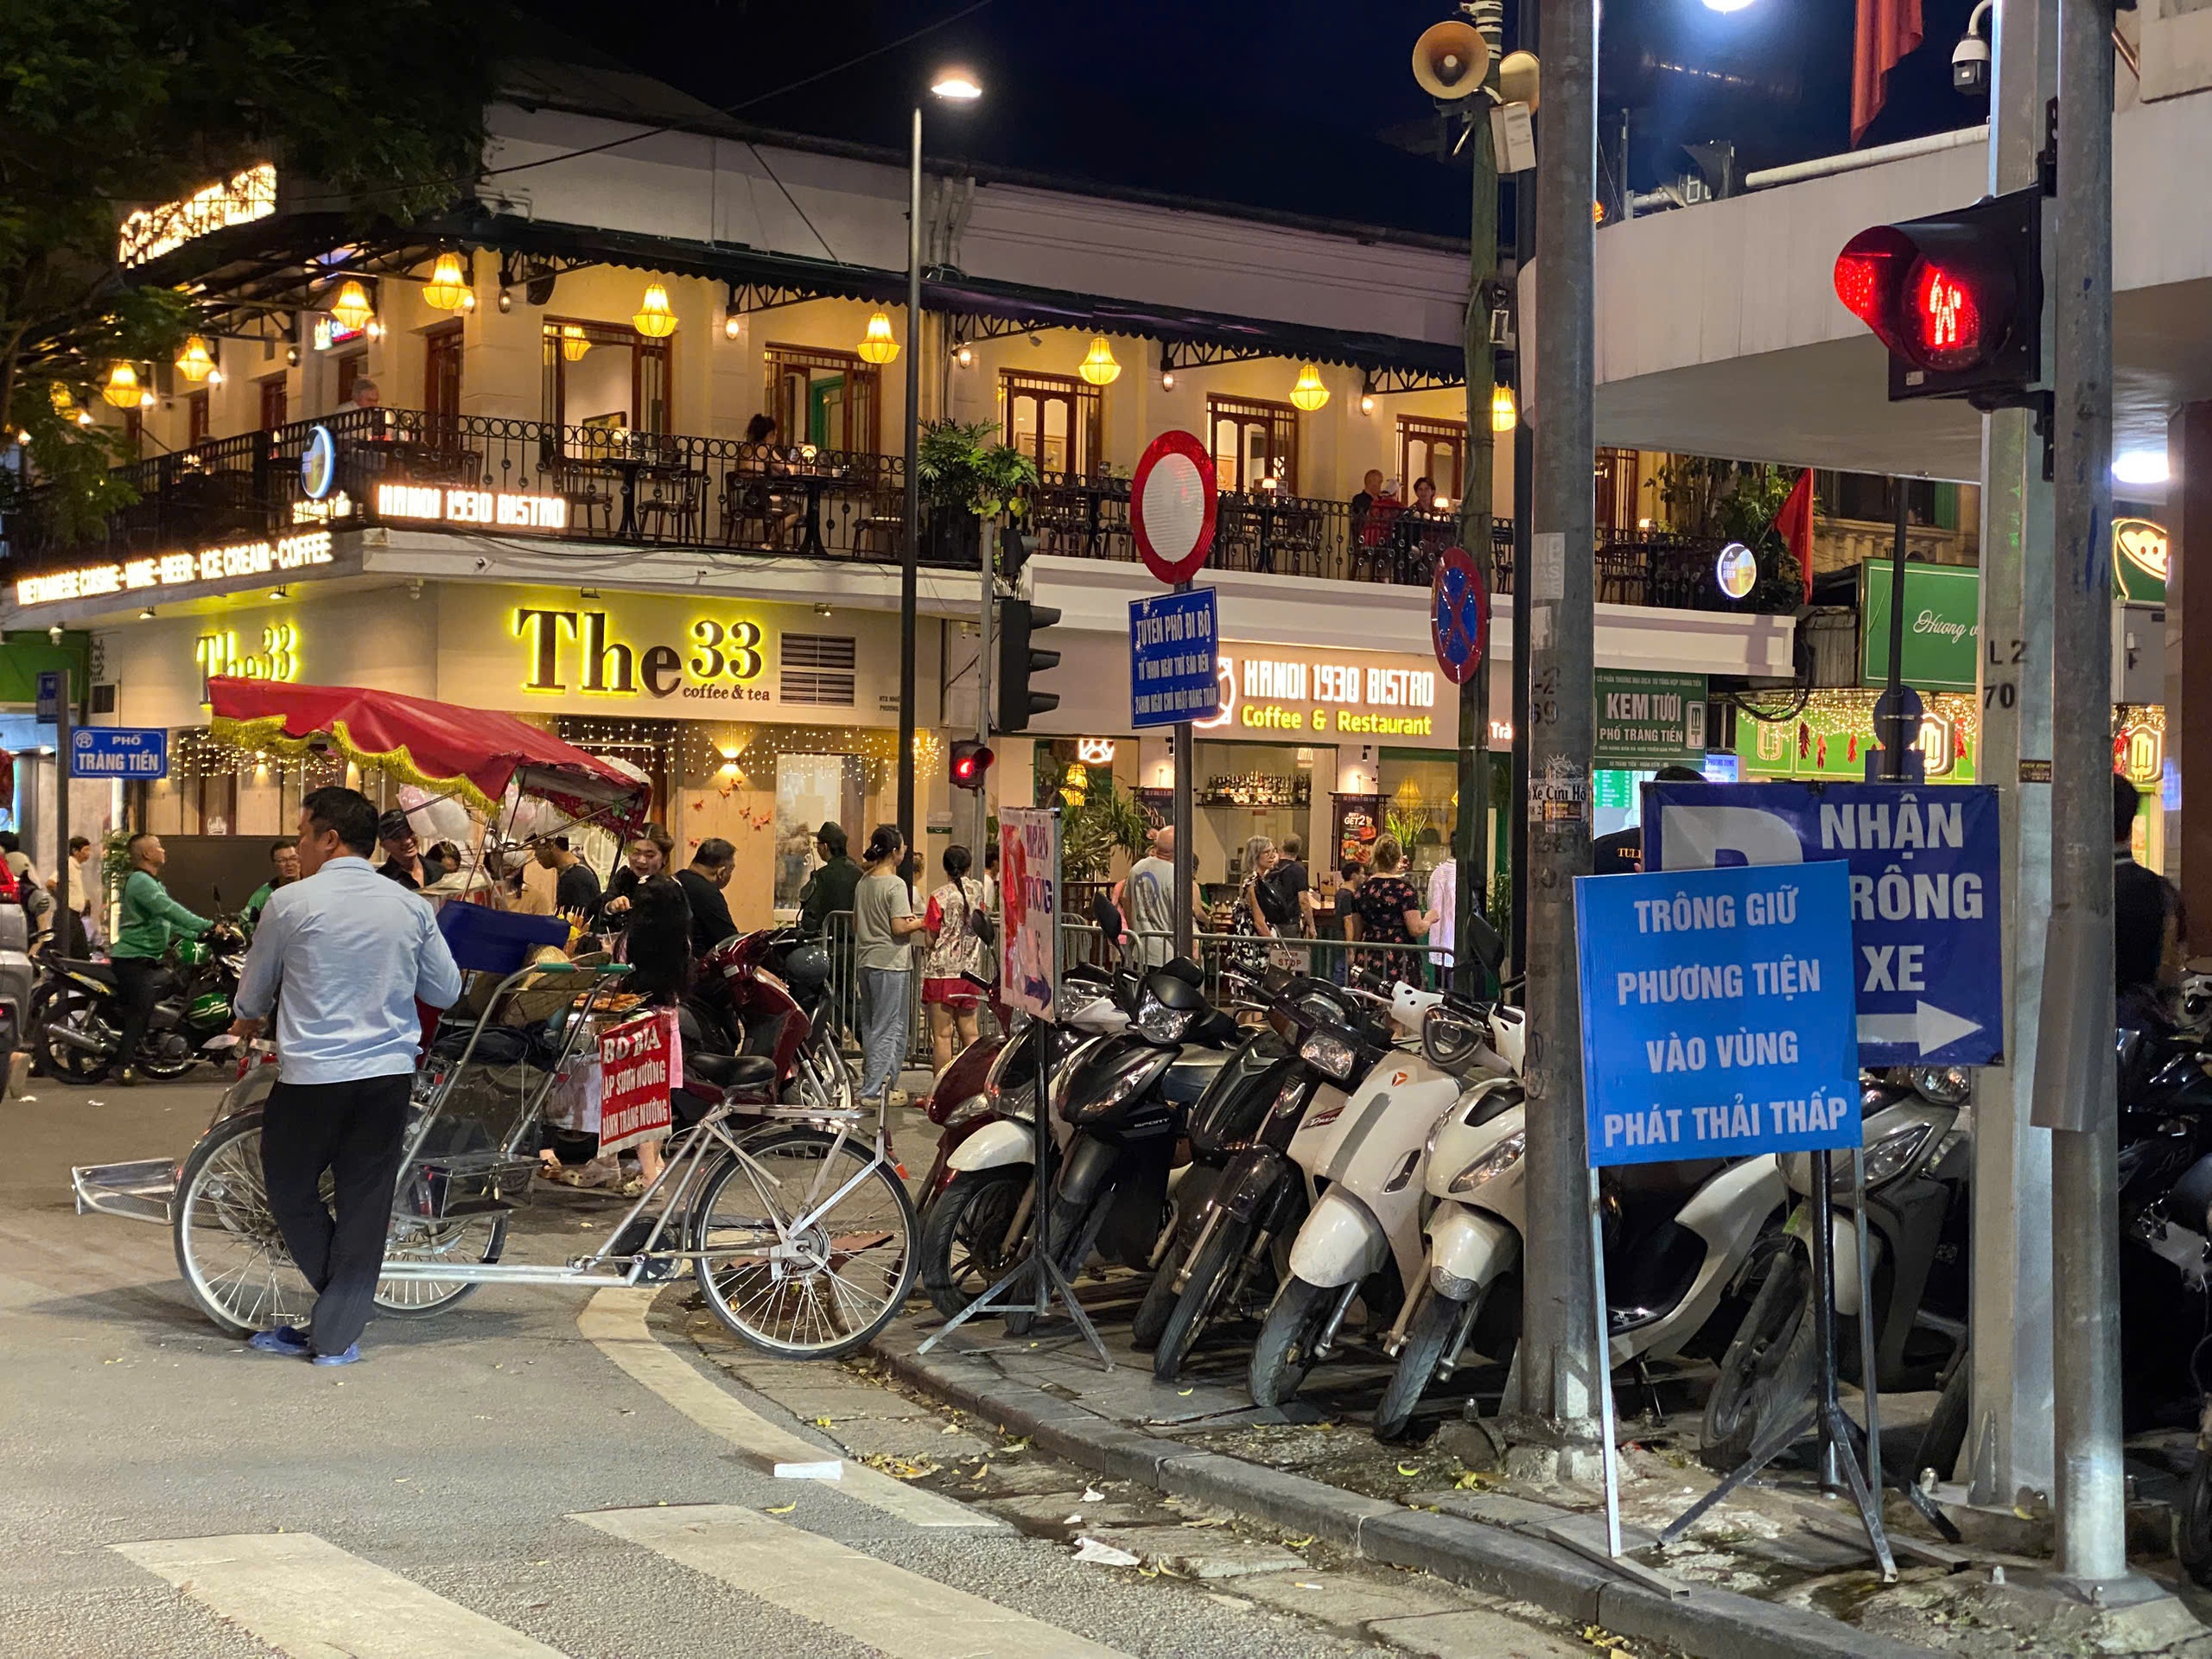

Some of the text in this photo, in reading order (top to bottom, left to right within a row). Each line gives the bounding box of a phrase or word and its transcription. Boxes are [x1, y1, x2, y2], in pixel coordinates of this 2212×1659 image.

[378, 484, 566, 528] HANOI 1930 BISTRO
[161, 553, 195, 583] BEER
[200, 549, 224, 579] ICE
[223, 542, 271, 576] CREAM
[278, 531, 334, 569] COFFEE
[1136, 603, 1211, 646] TUYẾN PHỐ ĐI BỘ
[263, 624, 297, 682] 33
[513, 607, 762, 698] The 33
[683, 683, 770, 701] coffee & tea
[1243, 659, 1434, 707] HANOI 1930 BISTRO
[1983, 683, 2015, 709] 70
[1242, 705, 1432, 735] Coffee & Restaurant
[1605, 692, 1681, 721] KEM TƯƠI
[111, 733, 142, 746] PHỐ
[1599, 724, 1683, 742] PHỐ TRÀNG TIỀN
[78, 749, 159, 772] TRÀNG TIỀN
[1532, 785, 1542, 800] Xe
[1573, 785, 1586, 804] Hộ
[1820, 793, 1964, 860] NHẬN
[1633, 885, 1799, 933] TRÔNG GIỮ
[1850, 864, 1983, 920] RÔNG
[1278, 958, 1301, 967] STOP
[1618, 954, 1821, 1006] PHƯƠNG TIỆN
[1860, 944, 1926, 992] XE
[1646, 1027, 1799, 1074] VÀO VÙNG
[1134, 1117, 1169, 1128] SPORT
[1604, 1086, 1847, 1148] PHÁT THẢI THẤP
